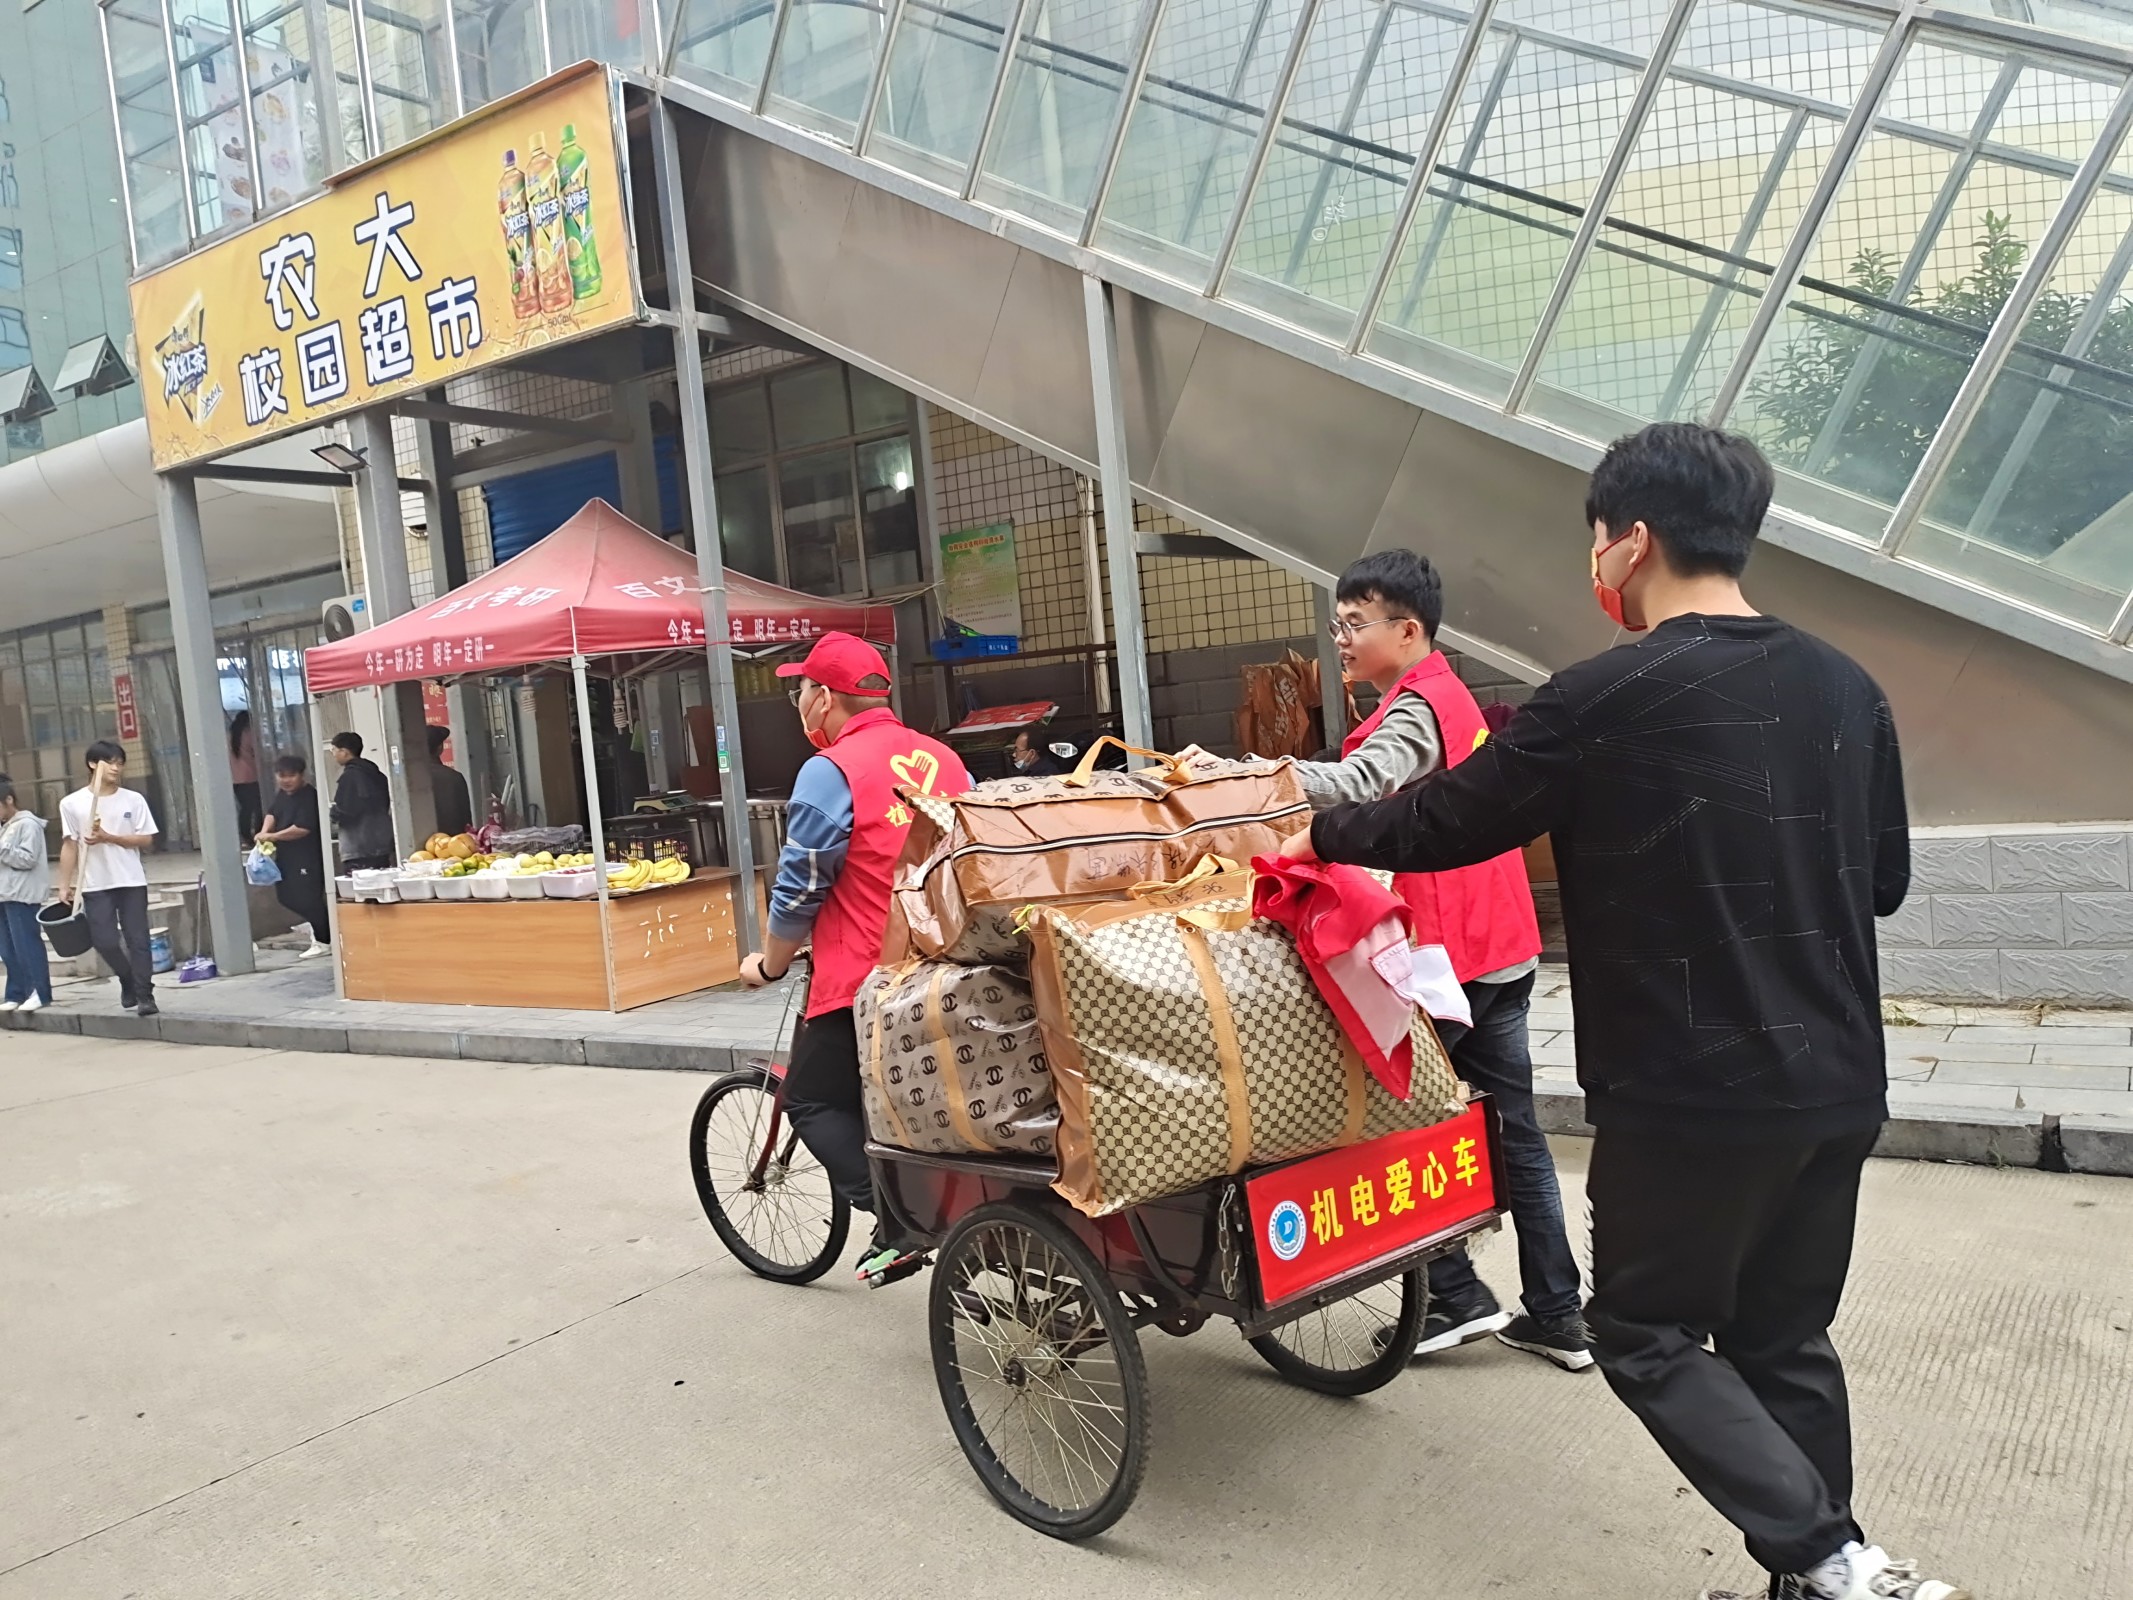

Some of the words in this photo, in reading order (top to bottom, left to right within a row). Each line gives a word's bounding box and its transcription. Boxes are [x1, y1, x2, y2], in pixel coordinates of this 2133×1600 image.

[259, 191, 423, 331] 农大
[163, 345, 207, 402] 冰红茶
[239, 276, 482, 427] 校园超市
[365, 644, 424, 678] 今年一研为定
[432, 636, 495, 668] 明年一定研一
[667, 618, 745, 645] 今年一定
[119, 682, 135, 732] 出口
[1310, 1137, 1479, 1245] 机电爱心车
